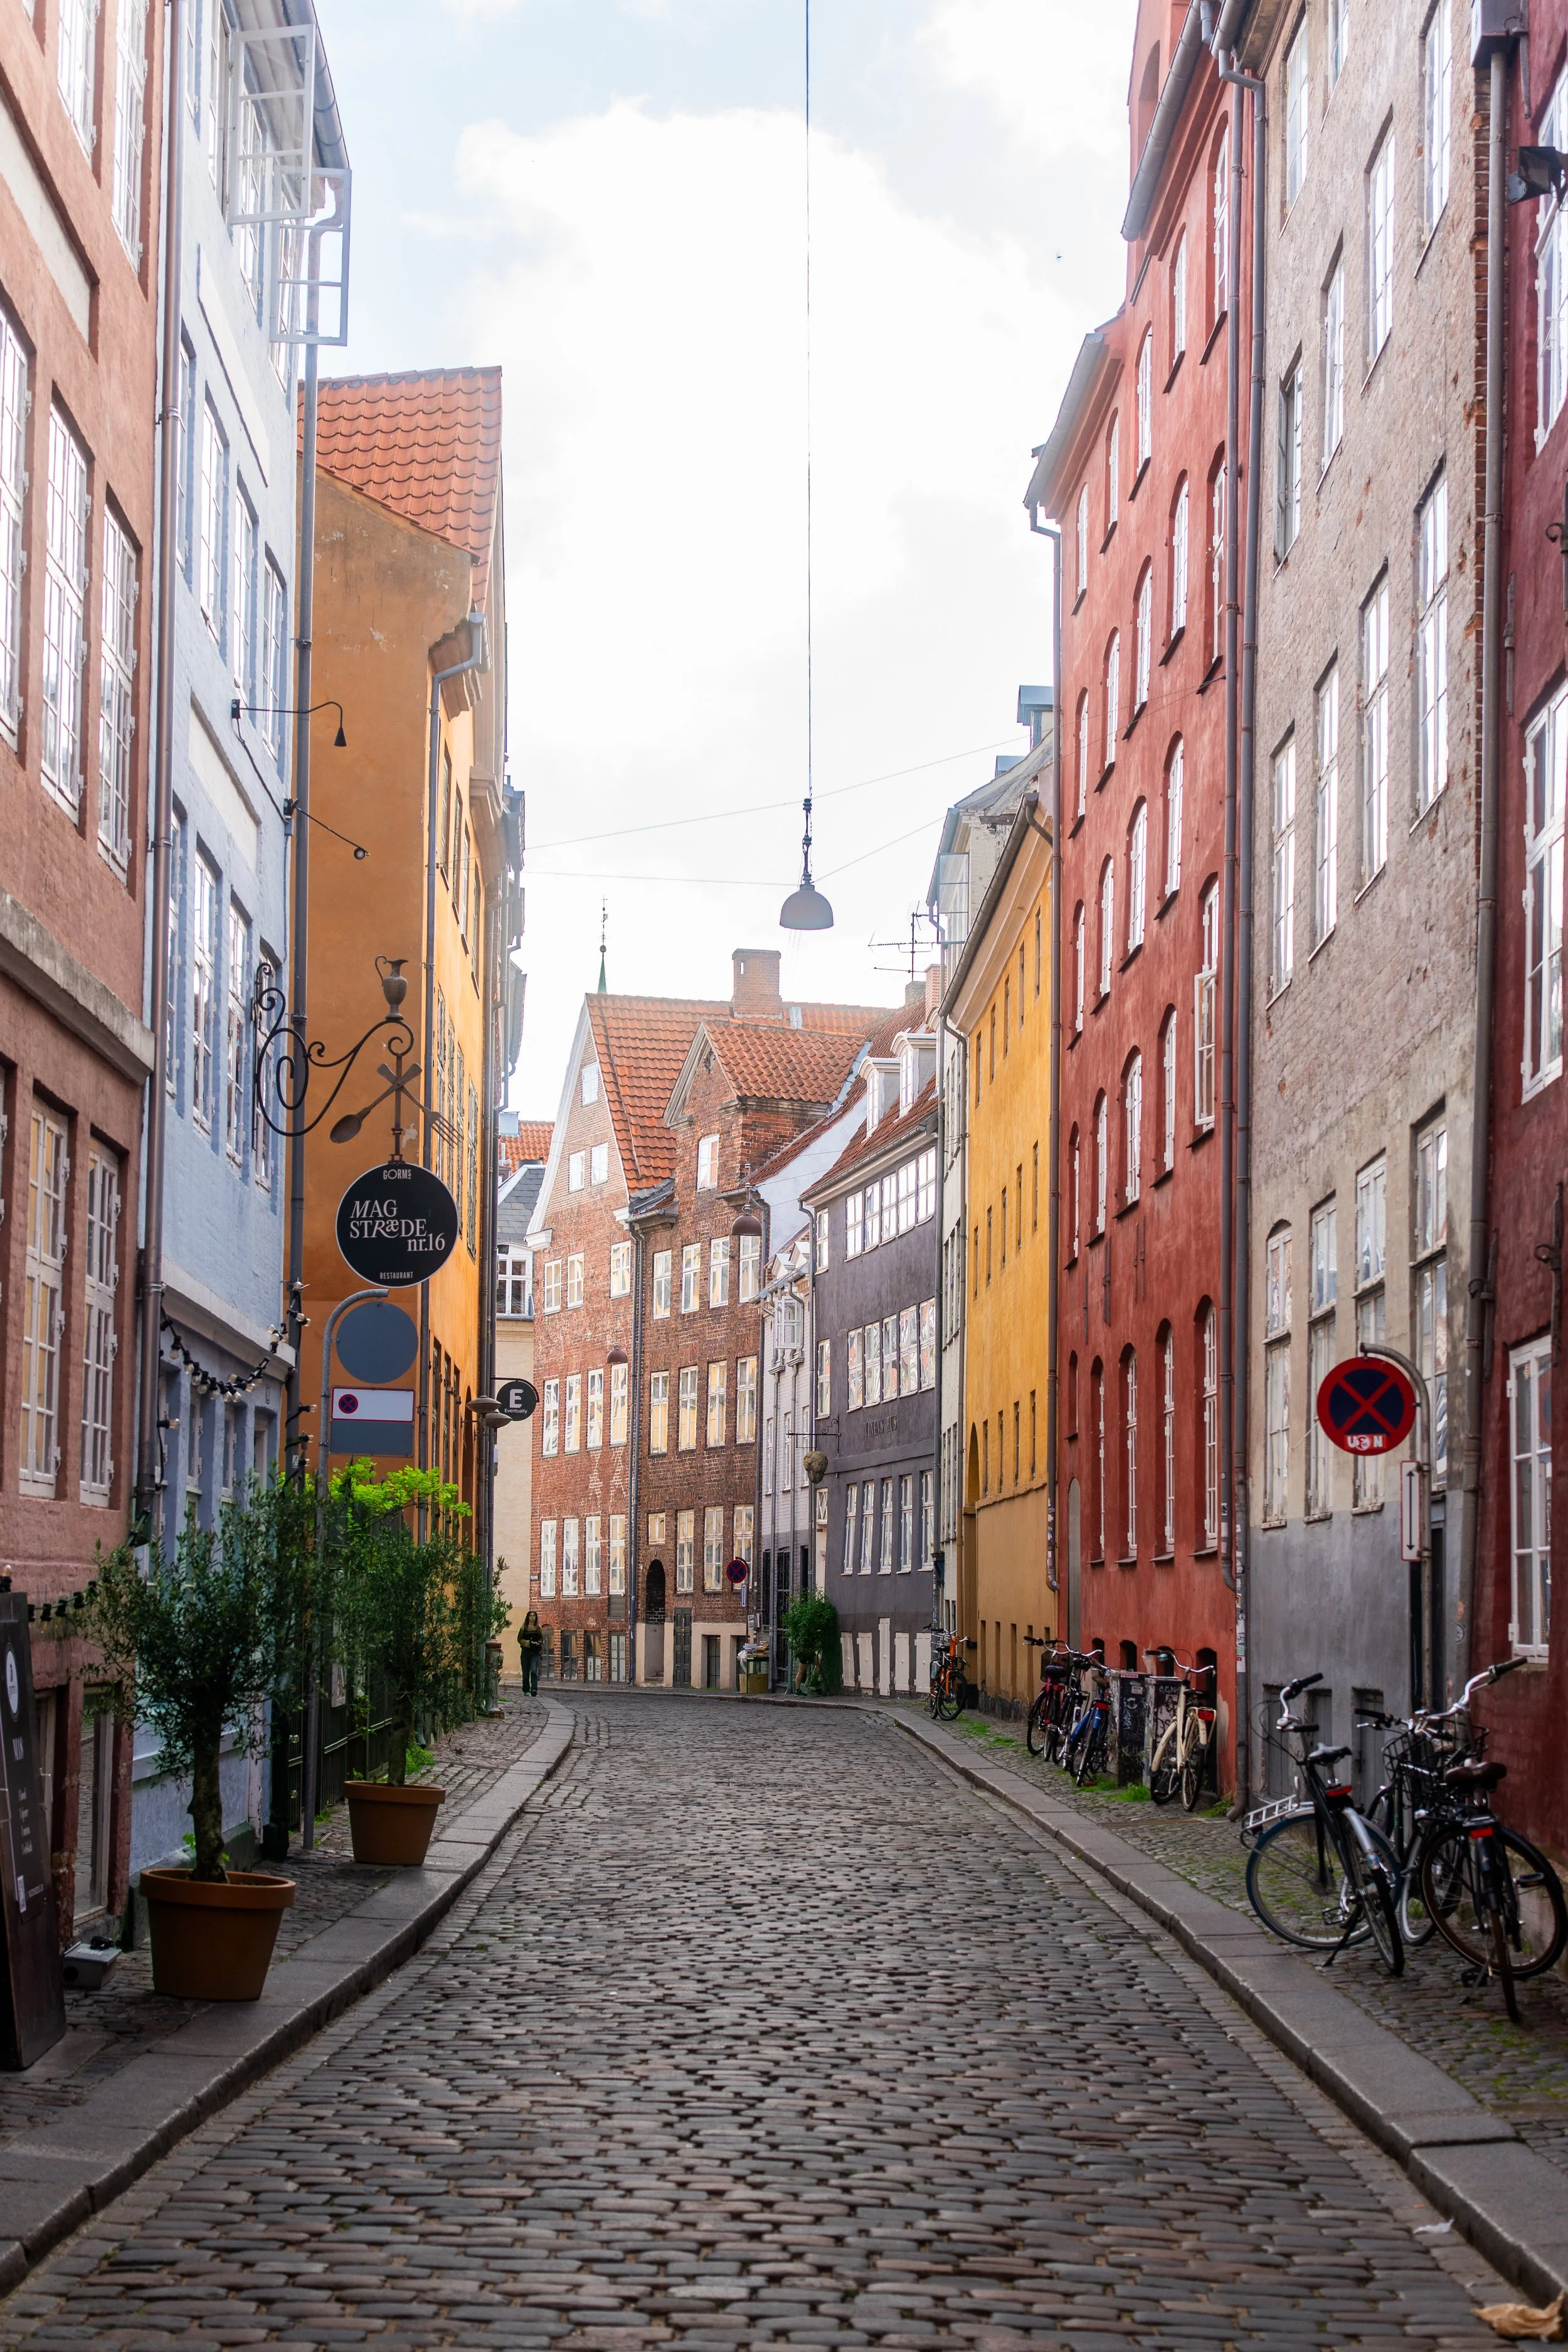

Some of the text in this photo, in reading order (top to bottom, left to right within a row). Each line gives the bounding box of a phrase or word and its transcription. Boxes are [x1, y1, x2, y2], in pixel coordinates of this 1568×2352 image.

[349, 1199, 398, 1219] MAG
[407, 1232, 445, 1252] nr.16
[379, 1271, 413, 1279] RESTAURANT
[509, 1389, 524, 1408] E
[864, 1416, 897, 1437] VINENS HUS
